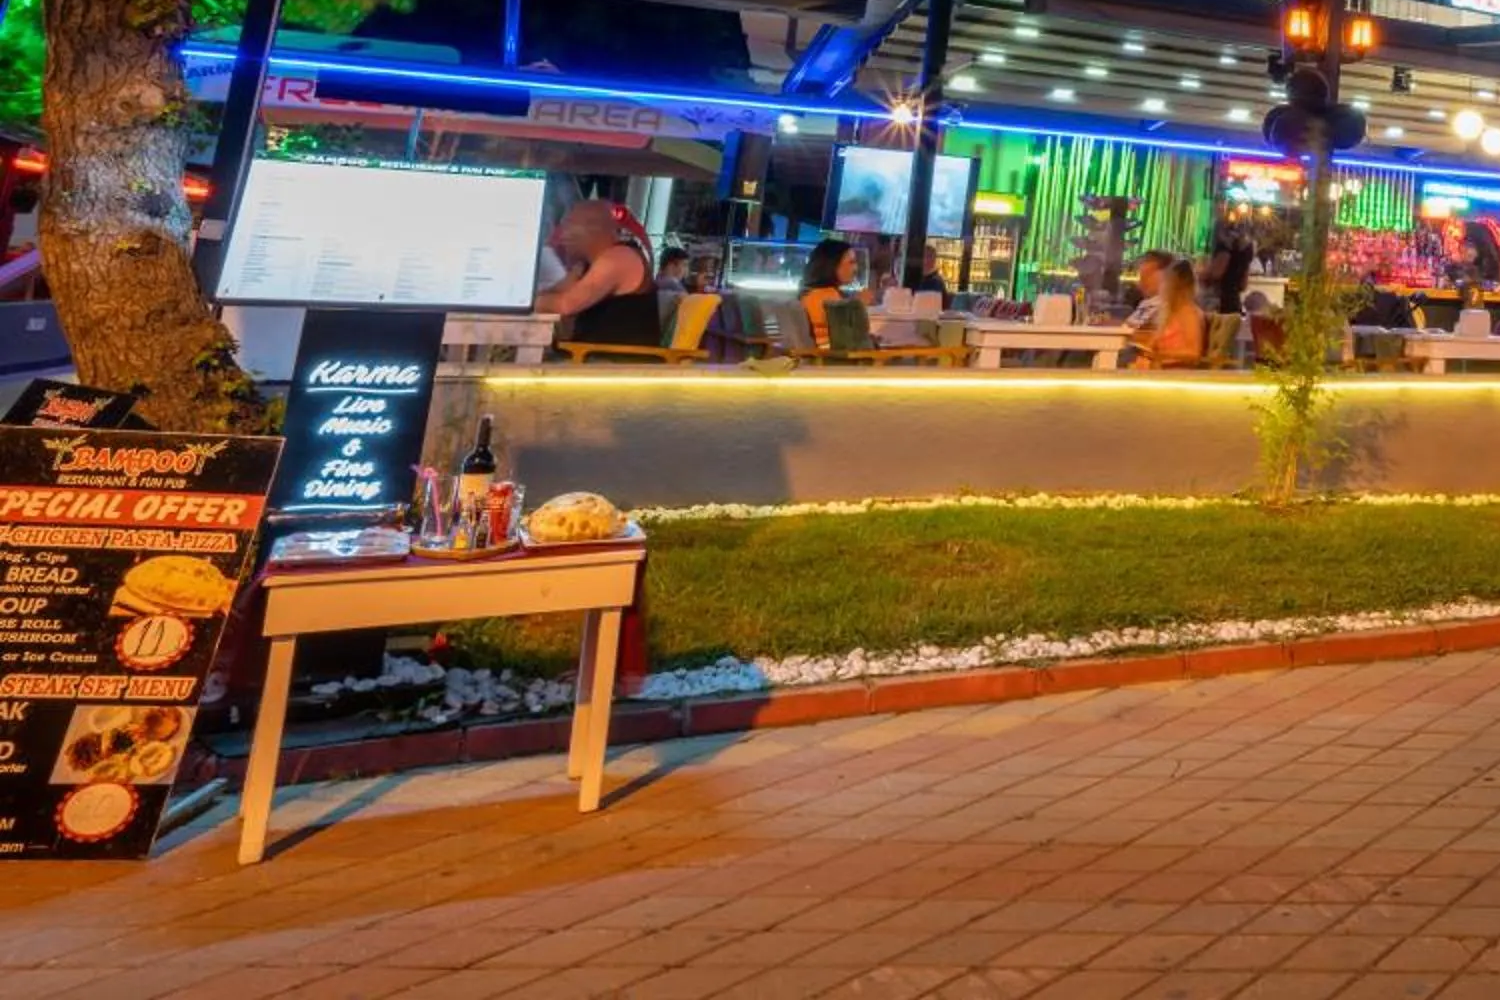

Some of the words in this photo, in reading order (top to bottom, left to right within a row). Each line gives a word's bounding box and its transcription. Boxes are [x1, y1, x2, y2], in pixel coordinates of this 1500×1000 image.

[534, 98, 664, 129] AREA
[309, 360, 421, 385] Karma
[332, 396, 388, 414] Live
[317, 417, 393, 436] Music
[342, 437, 363, 456] &
[60, 446, 198, 477] BAMBOO
[320, 459, 375, 478] Fine
[57, 474, 128, 488] RESTAURANT
[139, 476, 163, 488] FUN
[164, 477, 187, 489] PUB
[303, 479, 382, 501] Dining
[131, 494, 248, 525] OFFER
[11, 528, 107, 548] CHICKEN
[6, 566, 79, 584] BREAD
[0, 598, 49, 615] OUP
[21, 619, 62, 630] ROLL
[0, 632, 78, 644] USHROOM
[3, 676, 80, 697] STEAK
[80, 677, 127, 698] SET
[128, 678, 196, 699] MENU
